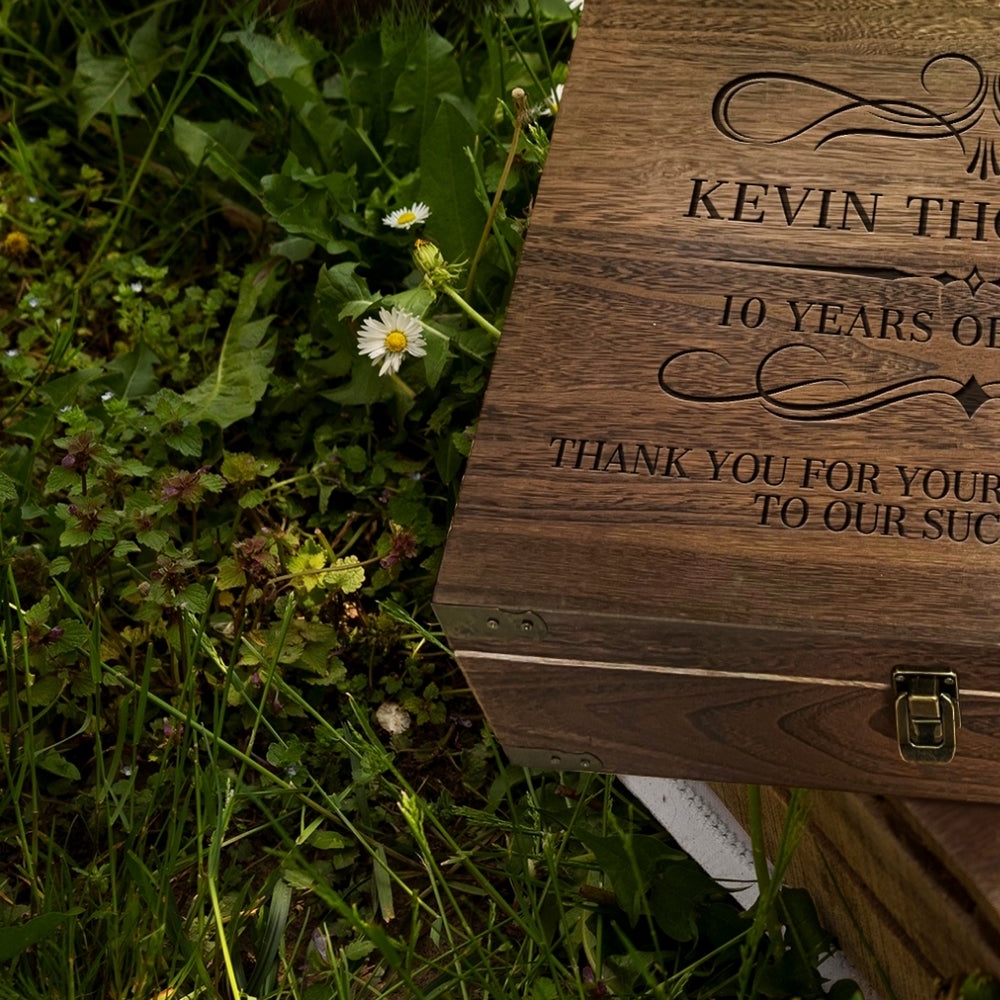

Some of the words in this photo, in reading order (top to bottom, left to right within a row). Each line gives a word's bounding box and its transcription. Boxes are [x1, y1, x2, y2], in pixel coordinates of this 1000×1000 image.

[683, 178, 883, 233] KEVIN
[718, 295, 767, 329] 10
[787, 300, 934, 343] YEARS
[550, 437, 693, 479] THANK
[706, 449, 790, 486] YOU
[801, 457, 882, 495] FOR
[754, 493, 809, 529] TO
[823, 500, 907, 537] OUR
